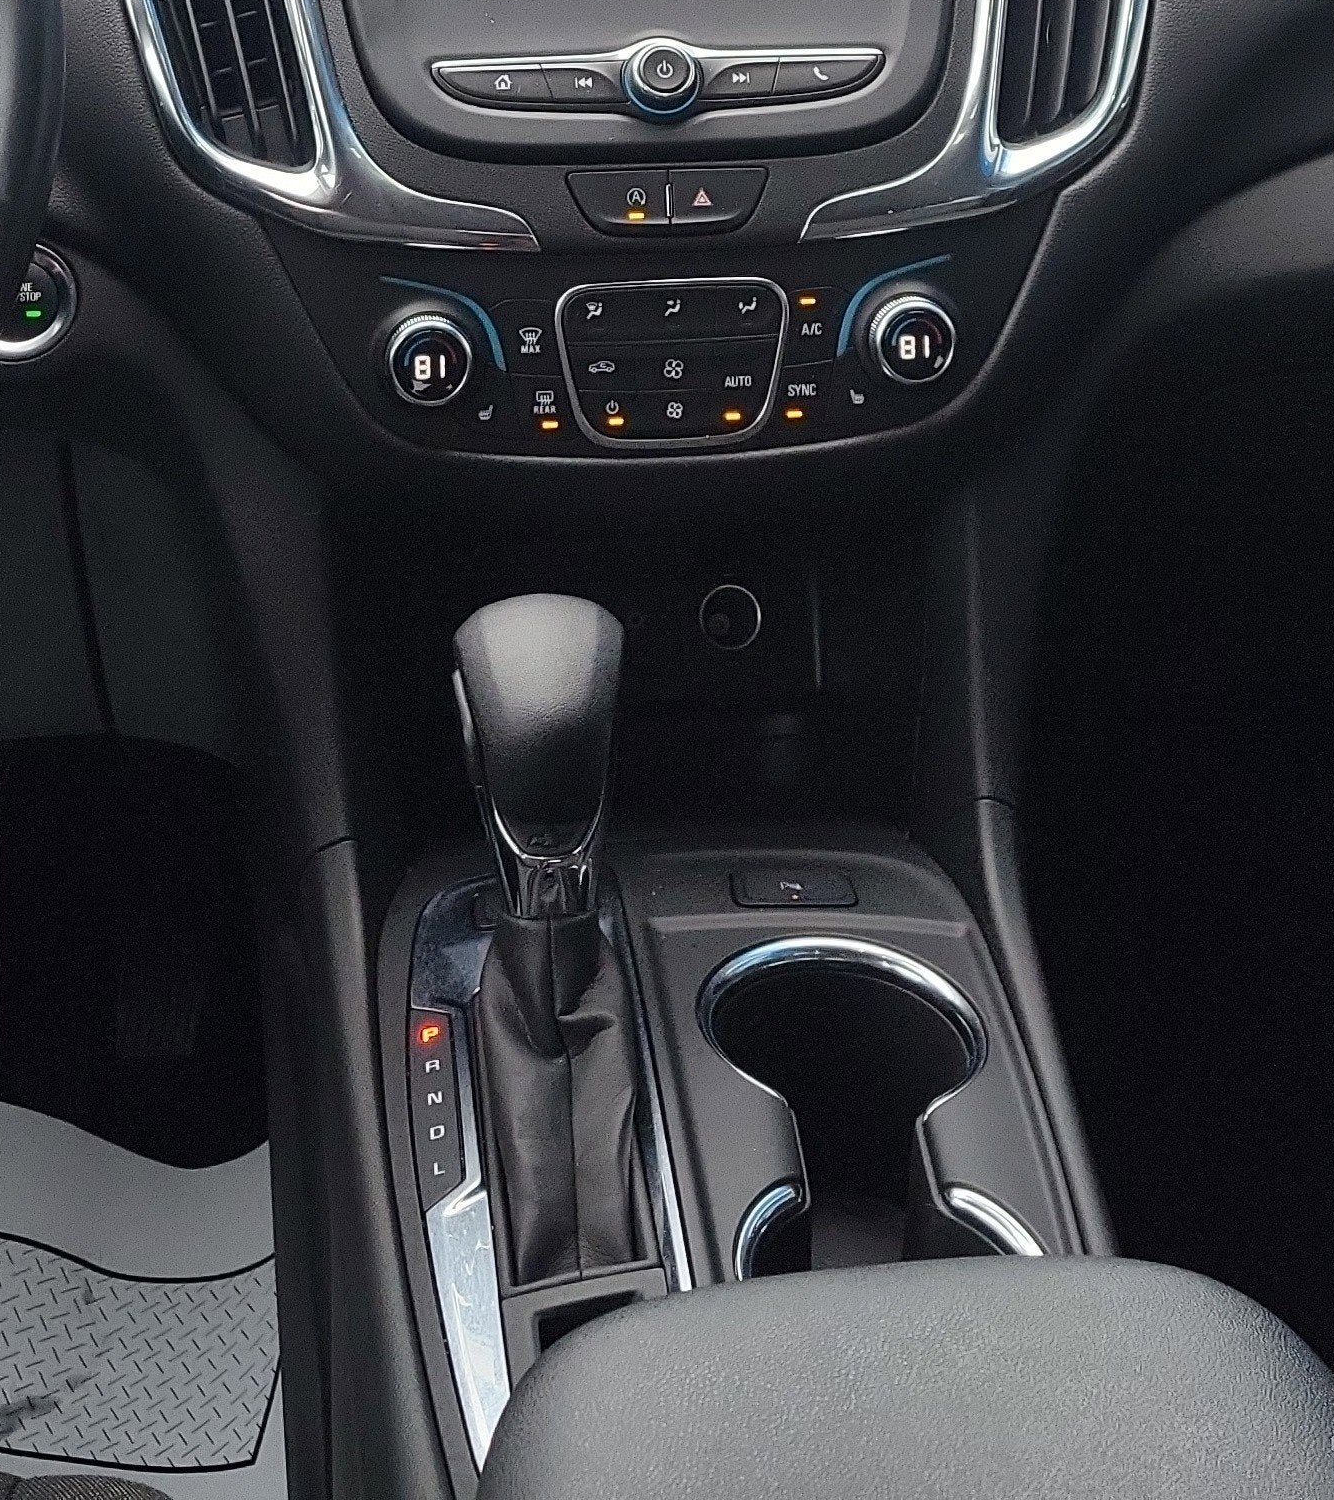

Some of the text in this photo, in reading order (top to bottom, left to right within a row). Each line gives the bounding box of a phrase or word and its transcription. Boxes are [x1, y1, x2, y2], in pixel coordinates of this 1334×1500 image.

[801, 322, 822, 337] A/C
[520, 344, 541, 354] MAX
[899, 334, 930, 360] 81
[414, 354, 446, 380] 81
[724, 375, 752, 388] AUTO
[787, 383, 817, 397] SYNC
[533, 405, 557, 414] REAR
[420, 1026, 439, 1043] P
[427, 1090, 442, 1106] N
[429, 1124, 445, 1141] D
[433, 1161, 446, 1176] L
